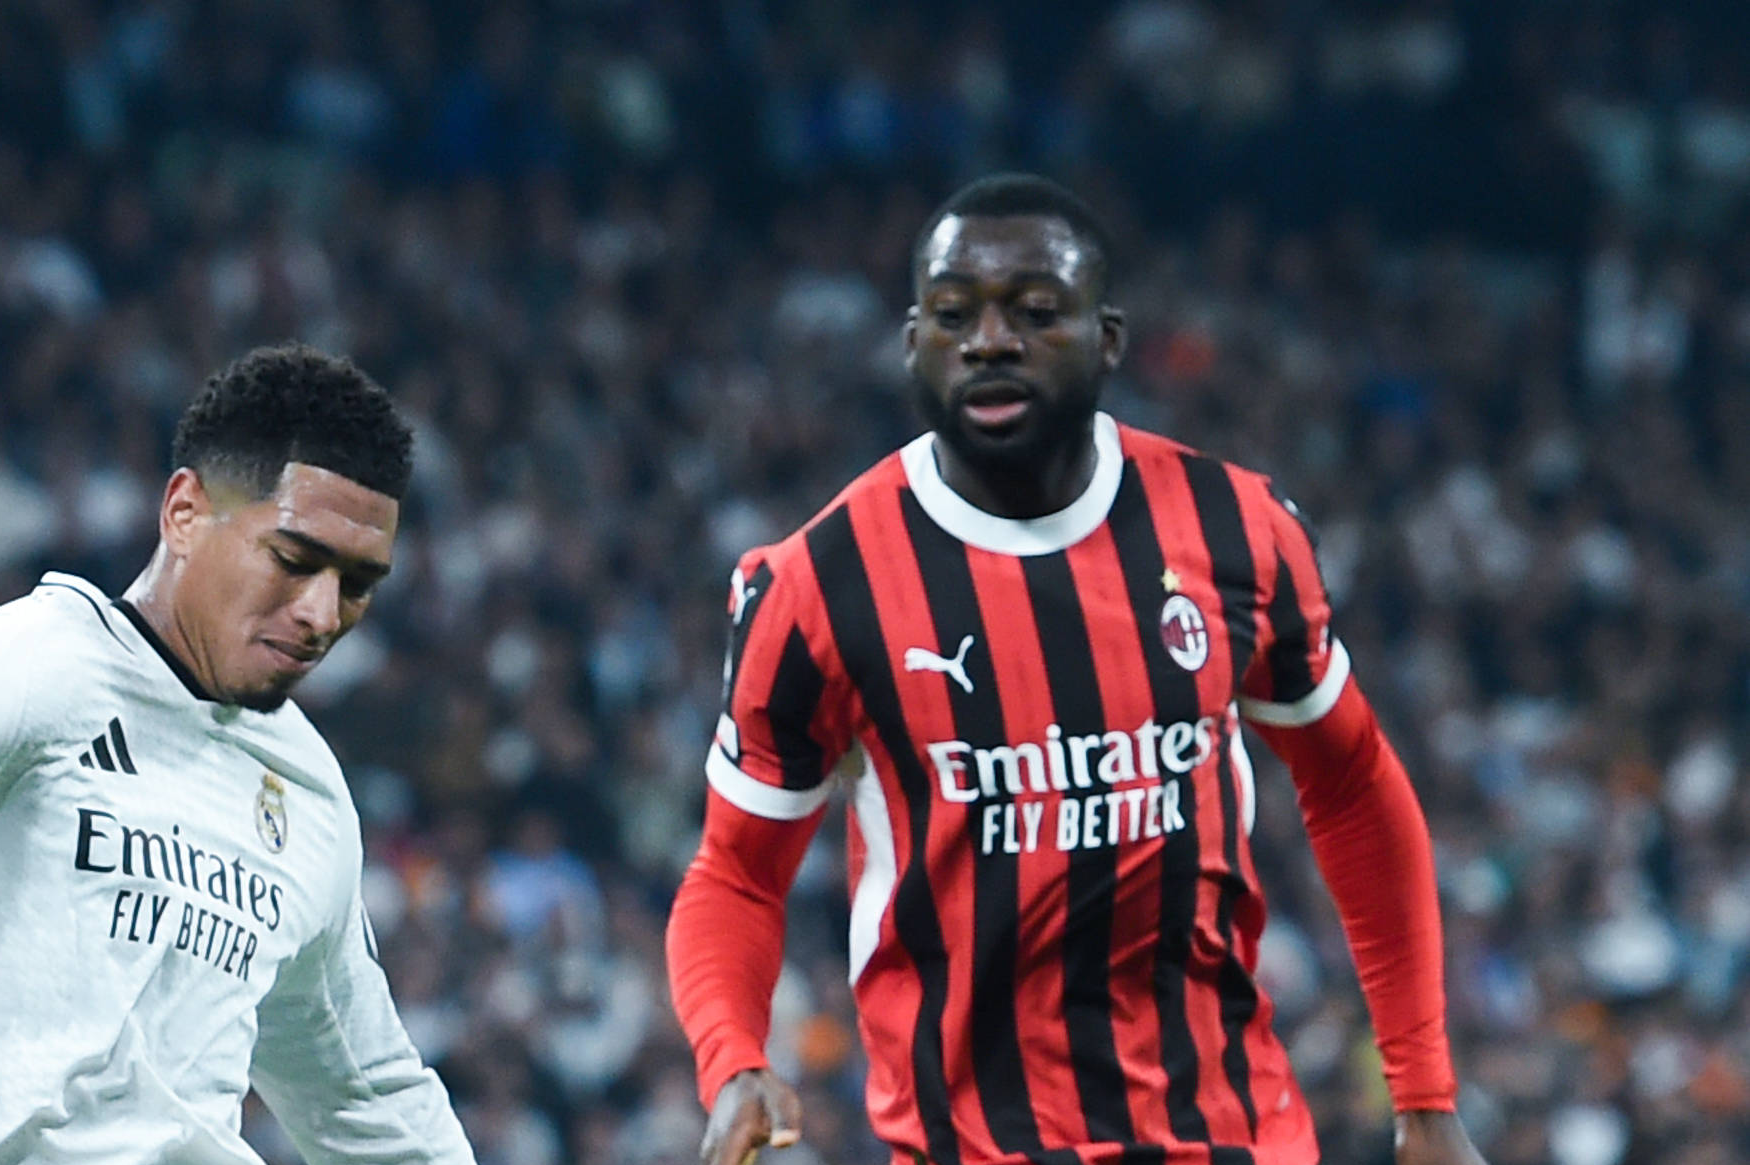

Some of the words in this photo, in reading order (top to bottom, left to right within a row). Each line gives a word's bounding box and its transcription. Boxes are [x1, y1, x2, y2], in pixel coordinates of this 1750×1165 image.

[926, 716, 1215, 804] Emirates
[982, 800, 1044, 855] FLY
[1056, 779, 1186, 852] BETTER
[74, 807, 284, 932] Emirates
[109, 889, 170, 945] FLY
[175, 902, 258, 982] BETTER
